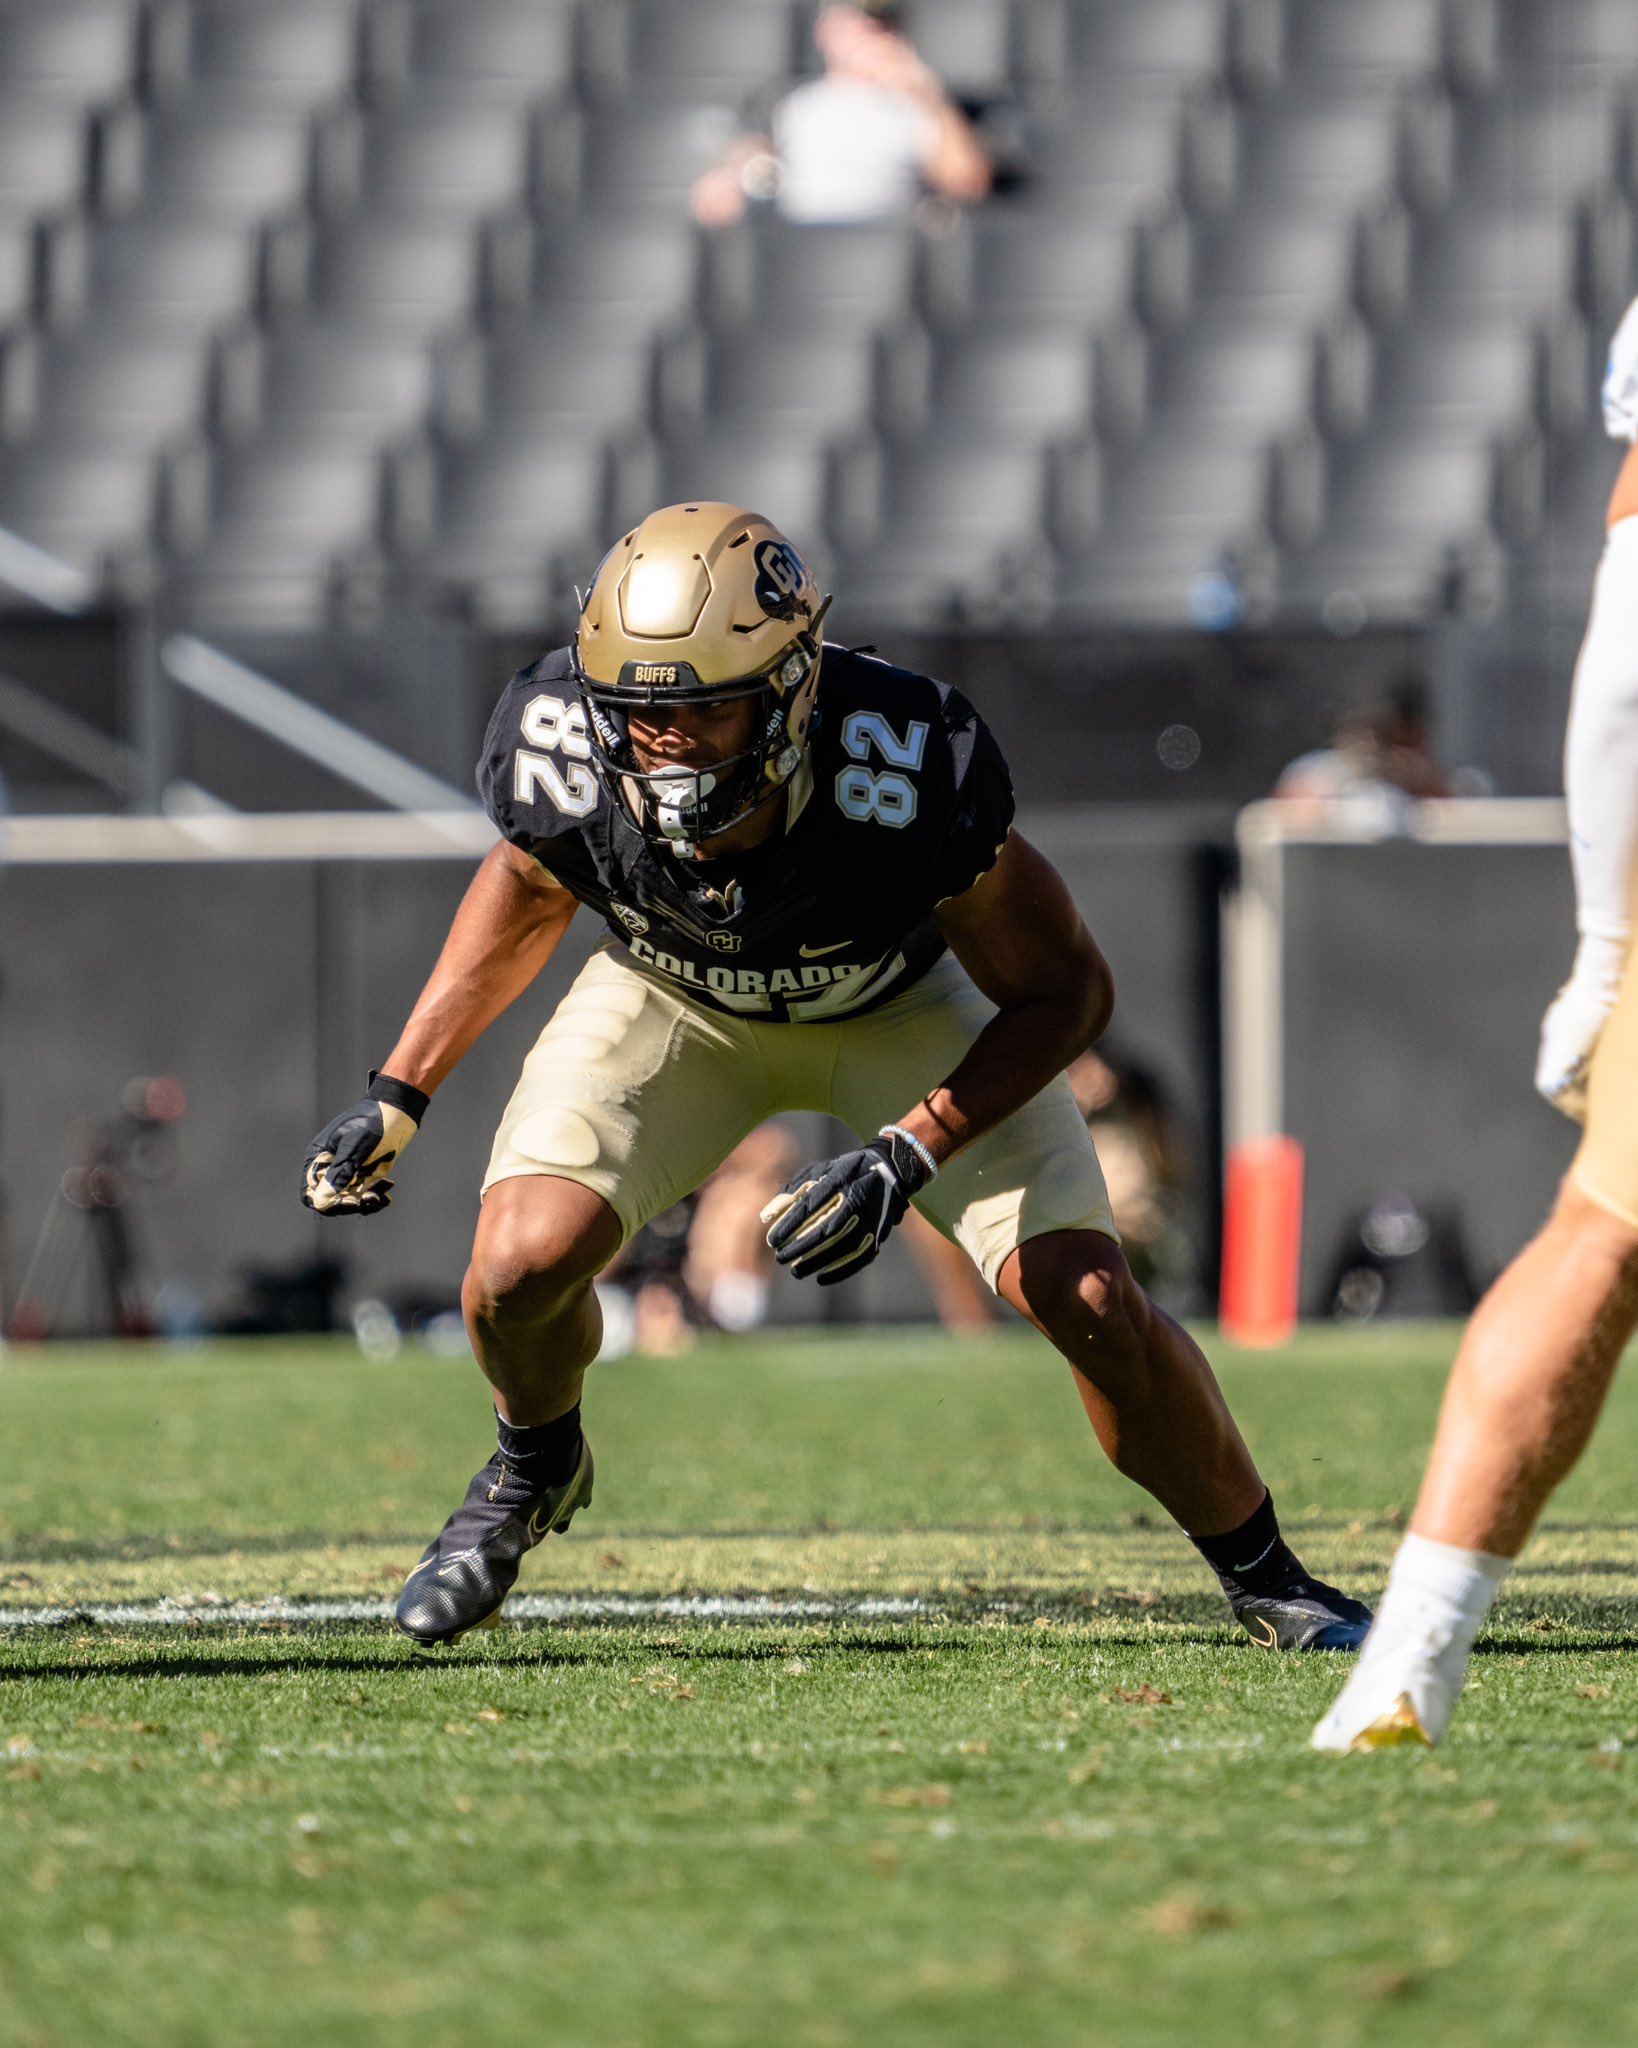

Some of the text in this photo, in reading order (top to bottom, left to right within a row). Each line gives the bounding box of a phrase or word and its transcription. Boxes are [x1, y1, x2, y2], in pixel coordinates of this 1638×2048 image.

[635, 665, 677, 683] BUFFS
[514, 694, 599, 819] 82
[835, 710, 930, 829] 82
[629, 936, 862, 993] COLORADO
